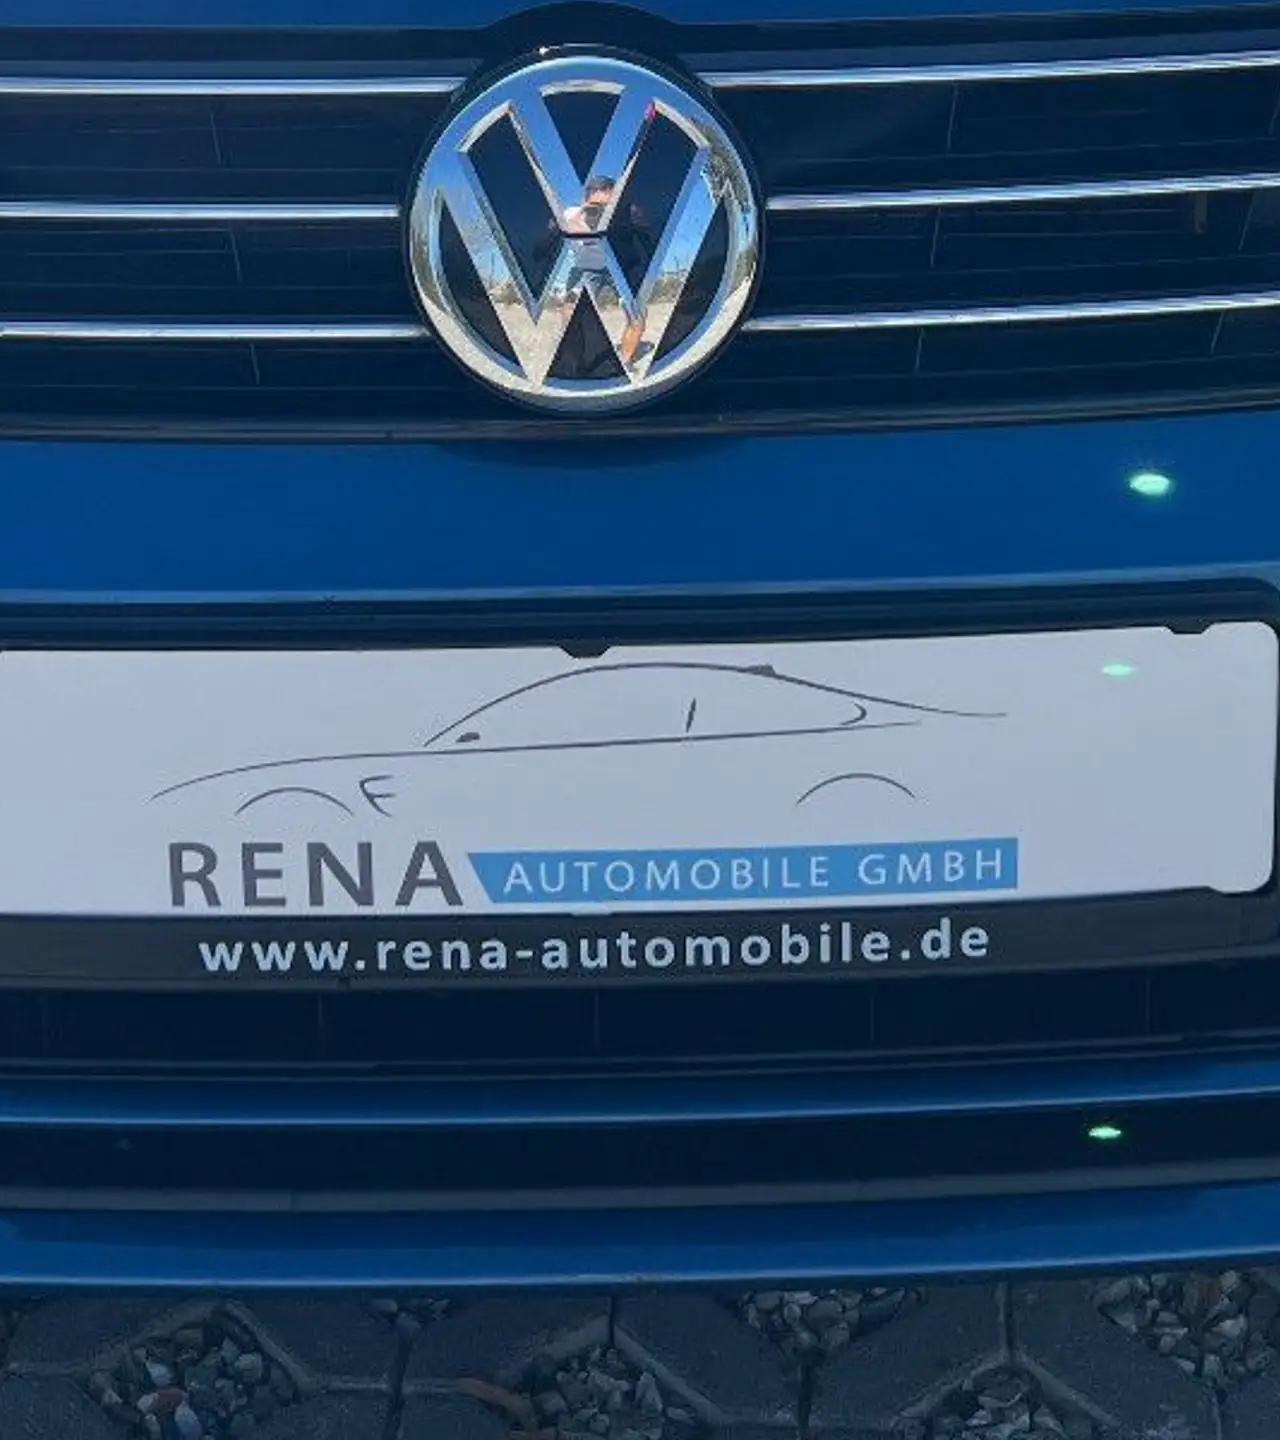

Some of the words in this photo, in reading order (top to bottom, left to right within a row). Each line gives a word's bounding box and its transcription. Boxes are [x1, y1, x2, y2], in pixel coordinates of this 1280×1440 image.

[168, 840, 464, 908] RENA
[502, 855, 830, 895] AUTOMOBILE
[857, 847, 1004, 887] GMBH
[198, 918, 991, 973] www.rena-automobile.de
